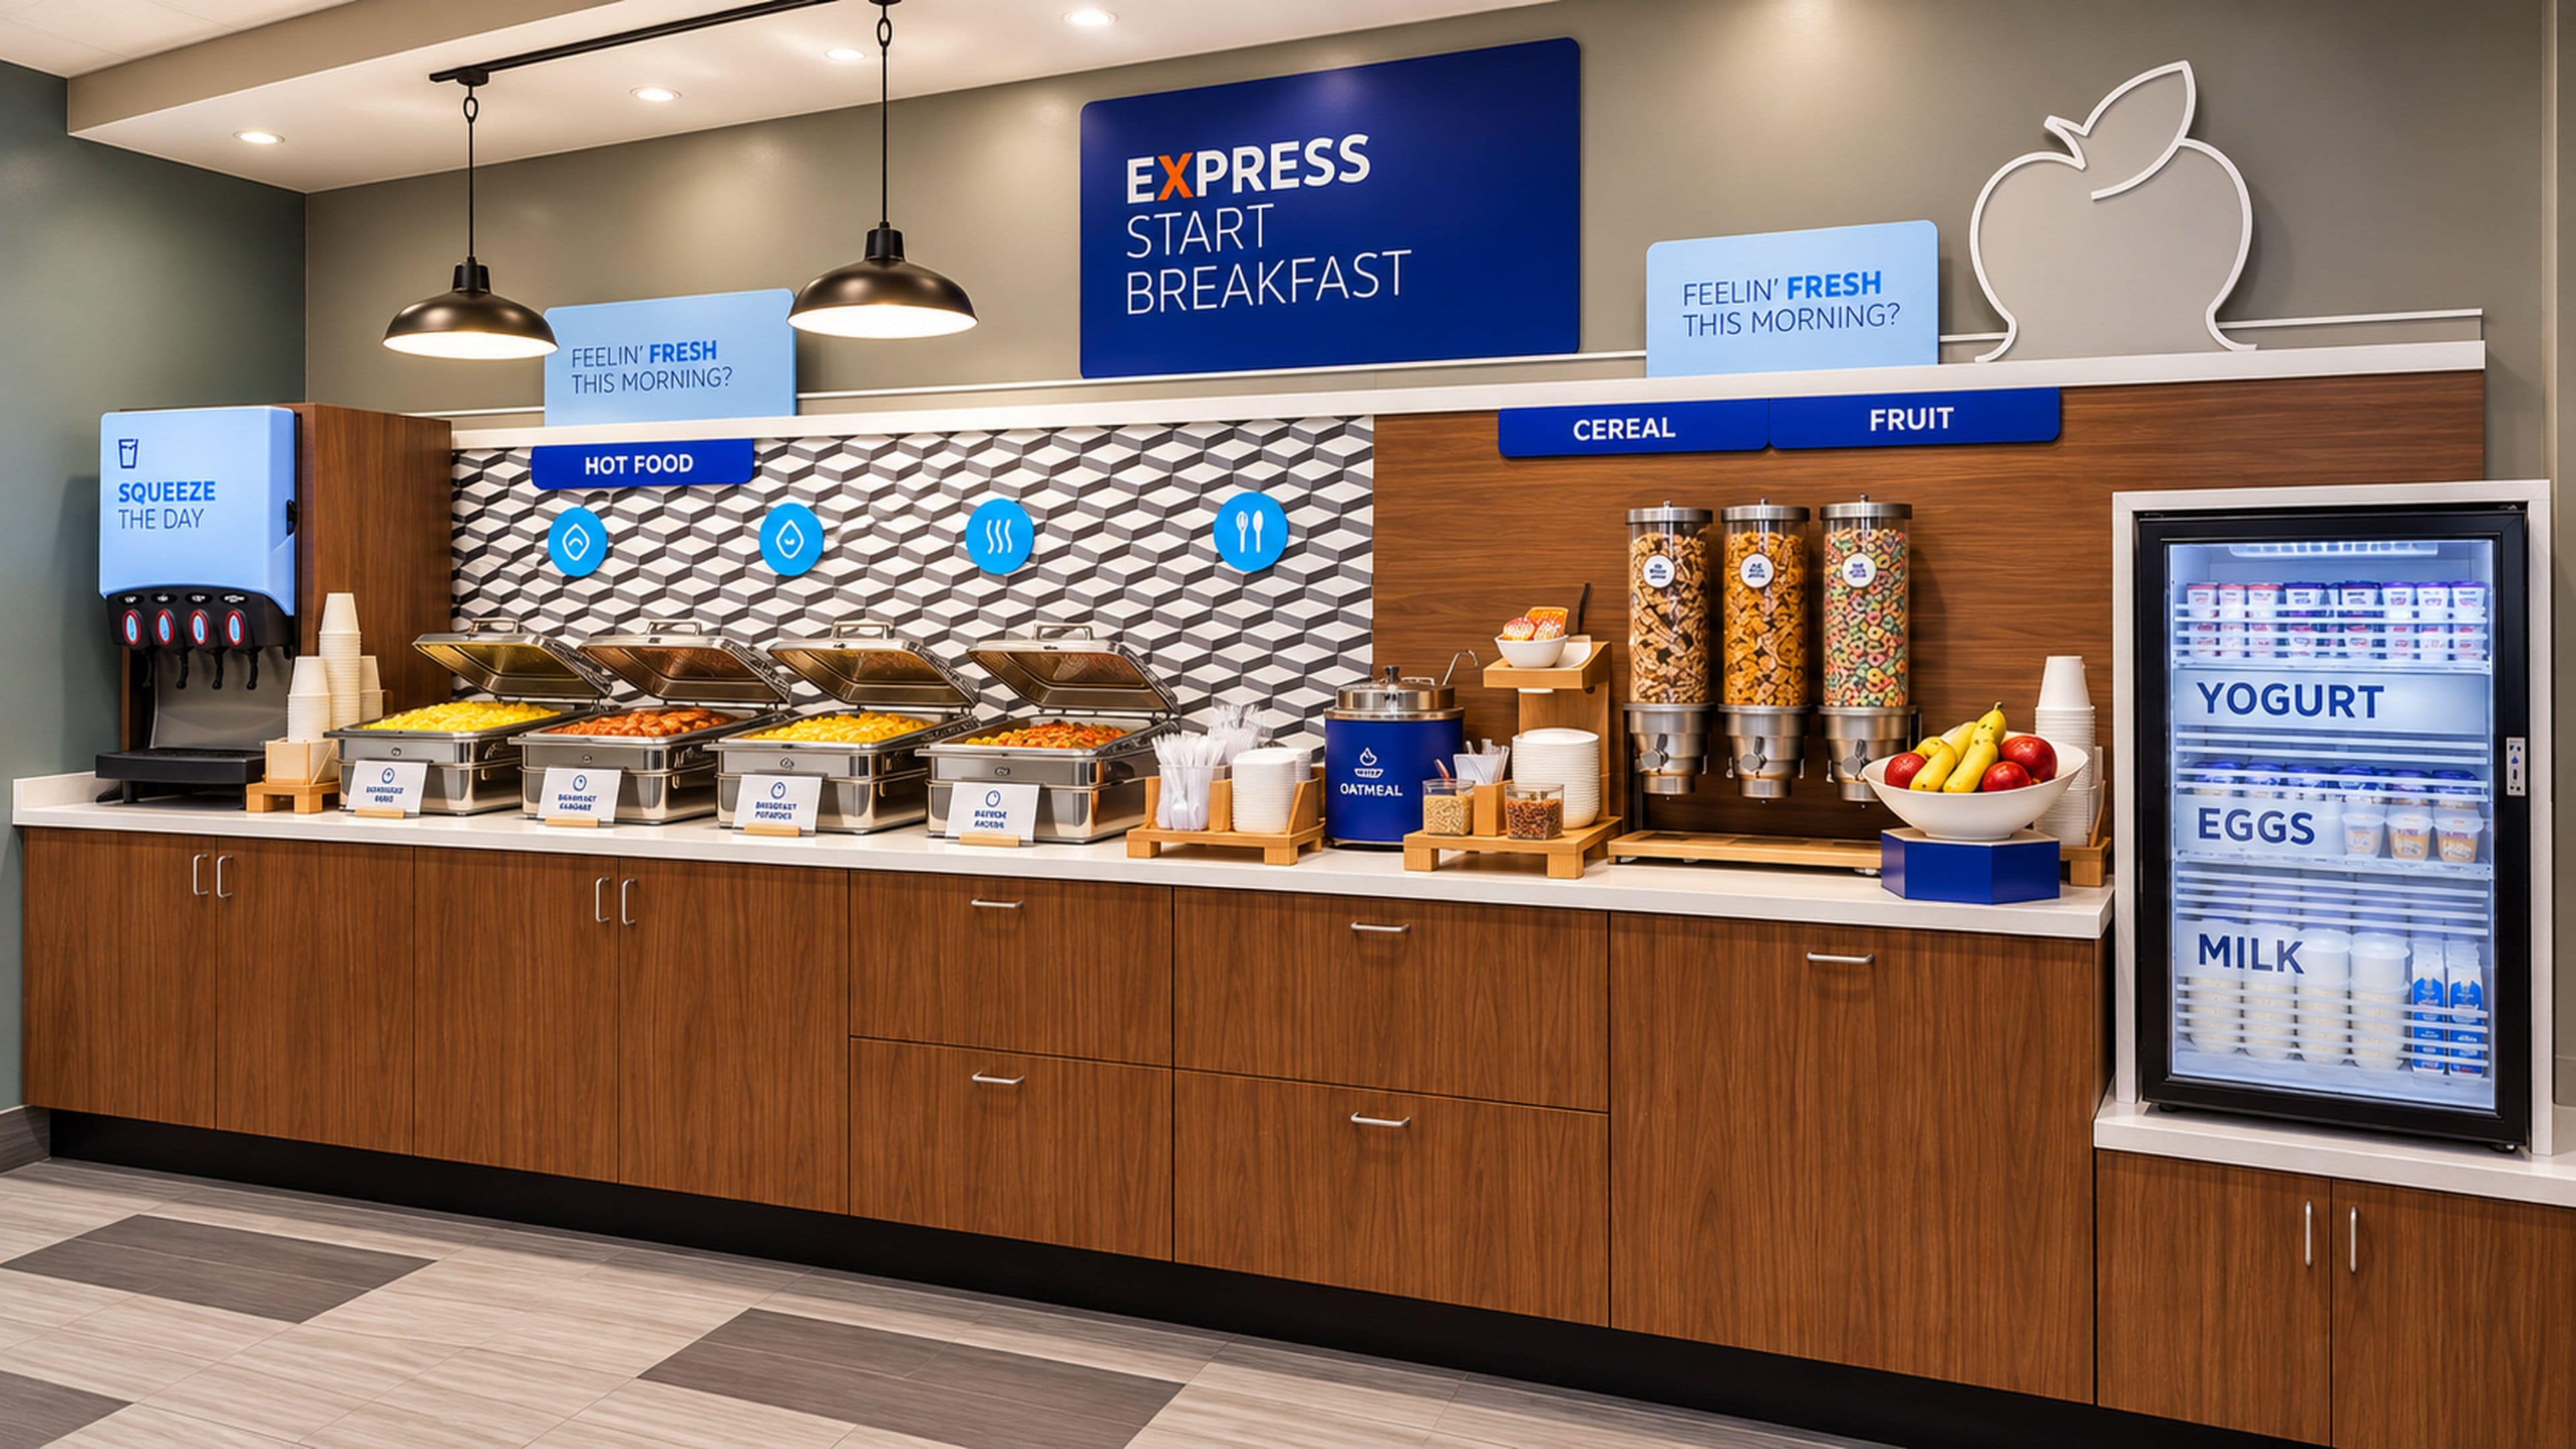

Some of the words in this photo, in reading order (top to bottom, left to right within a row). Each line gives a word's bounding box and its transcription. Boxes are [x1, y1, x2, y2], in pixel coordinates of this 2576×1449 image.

[1127, 133, 1371, 204] EXPRESS
[1126, 203, 1275, 258] START
[1127, 249, 1412, 315] BREAKFAST
[1787, 270, 1881, 300] FRESH
[1682, 311, 1742, 337] THIS
[1752, 303, 1901, 333] MORNING?
[649, 340, 717, 364] FRESH
[572, 372, 615, 394] THIS
[621, 366, 733, 392] MORNING?
[1572, 417, 1676, 441] CEREAL
[1870, 407, 1954, 431] FRUIT
[585, 455, 628, 475] HOT
[634, 453, 694, 474] FOOD
[118, 481, 215, 504] SQUEEZE
[118, 508, 156, 529] THE
[164, 508, 204, 529] DAY
[2196, 682, 2384, 719] YOGURT
[1340, 783, 1403, 797] OATMEAL
[2198, 808, 2316, 845] EGGS
[2199, 933, 2304, 974] MILK
